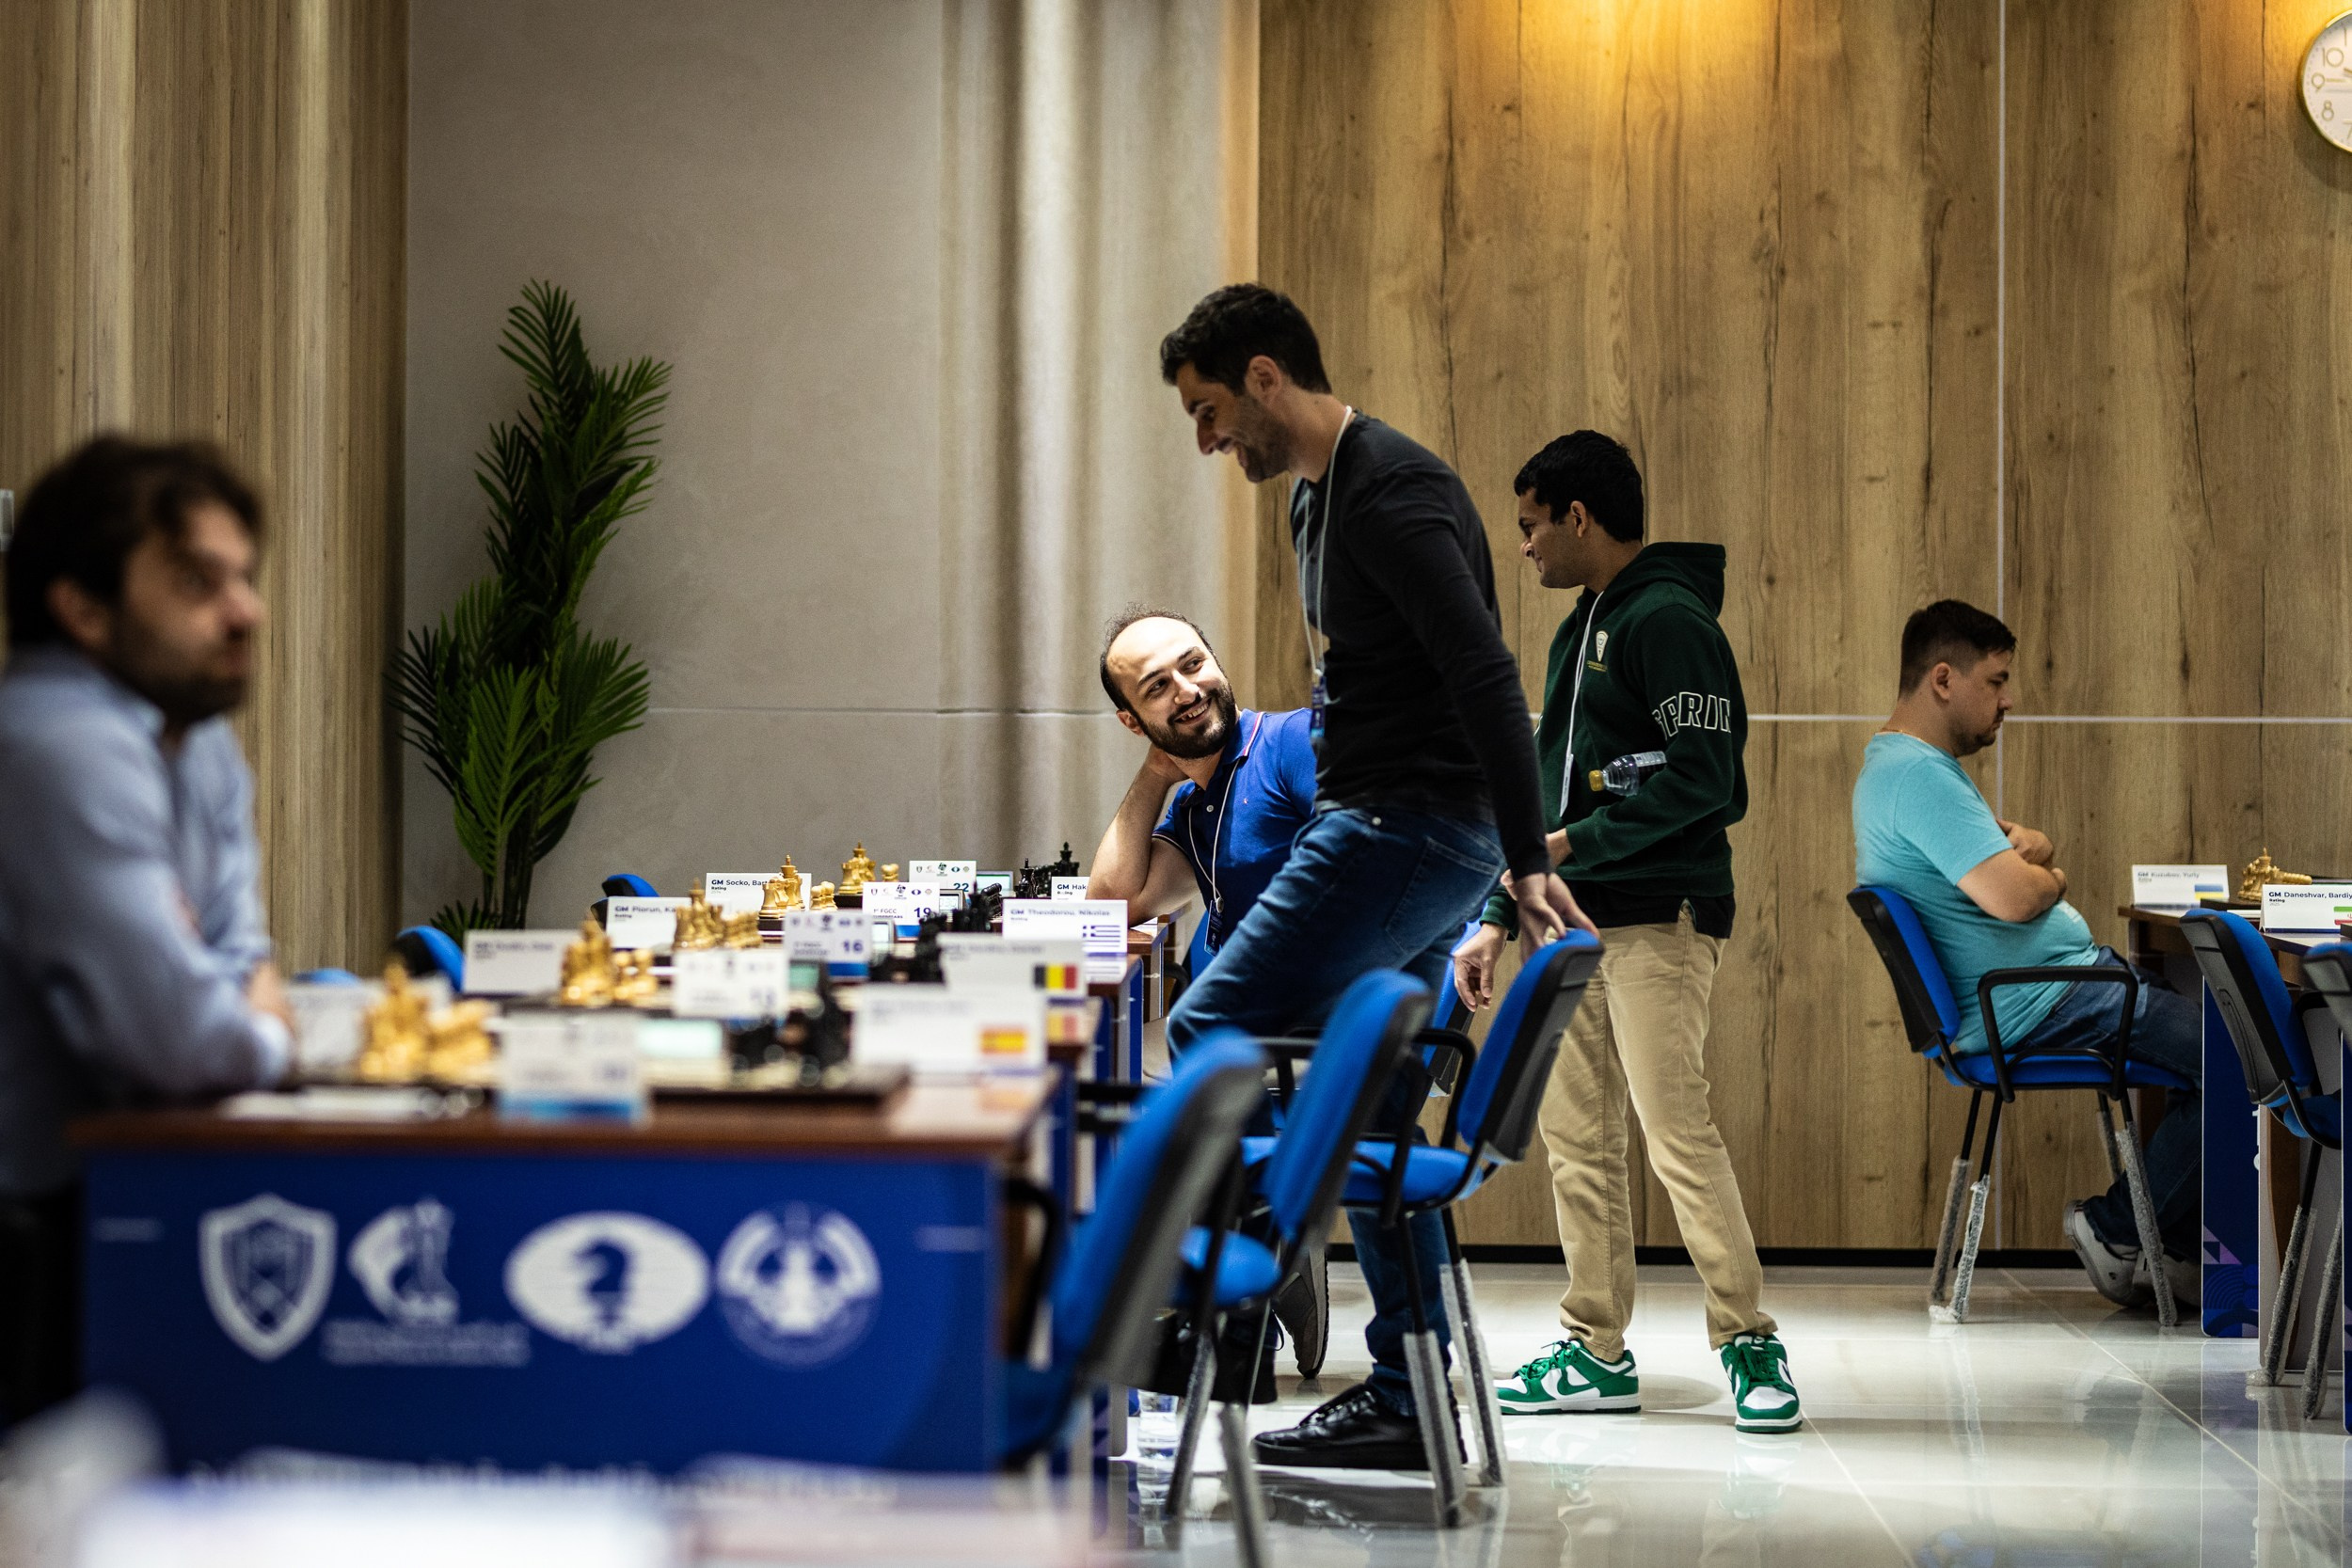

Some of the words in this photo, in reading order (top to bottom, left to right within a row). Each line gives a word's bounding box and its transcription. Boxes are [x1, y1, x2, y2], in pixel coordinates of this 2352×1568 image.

[2322, 47, 2344, 68] 10
[2312, 72, 2326, 92] 9
[2321, 100, 2335, 121] 8
[953, 882, 969, 892] 22
[914, 907, 932, 918] 19
